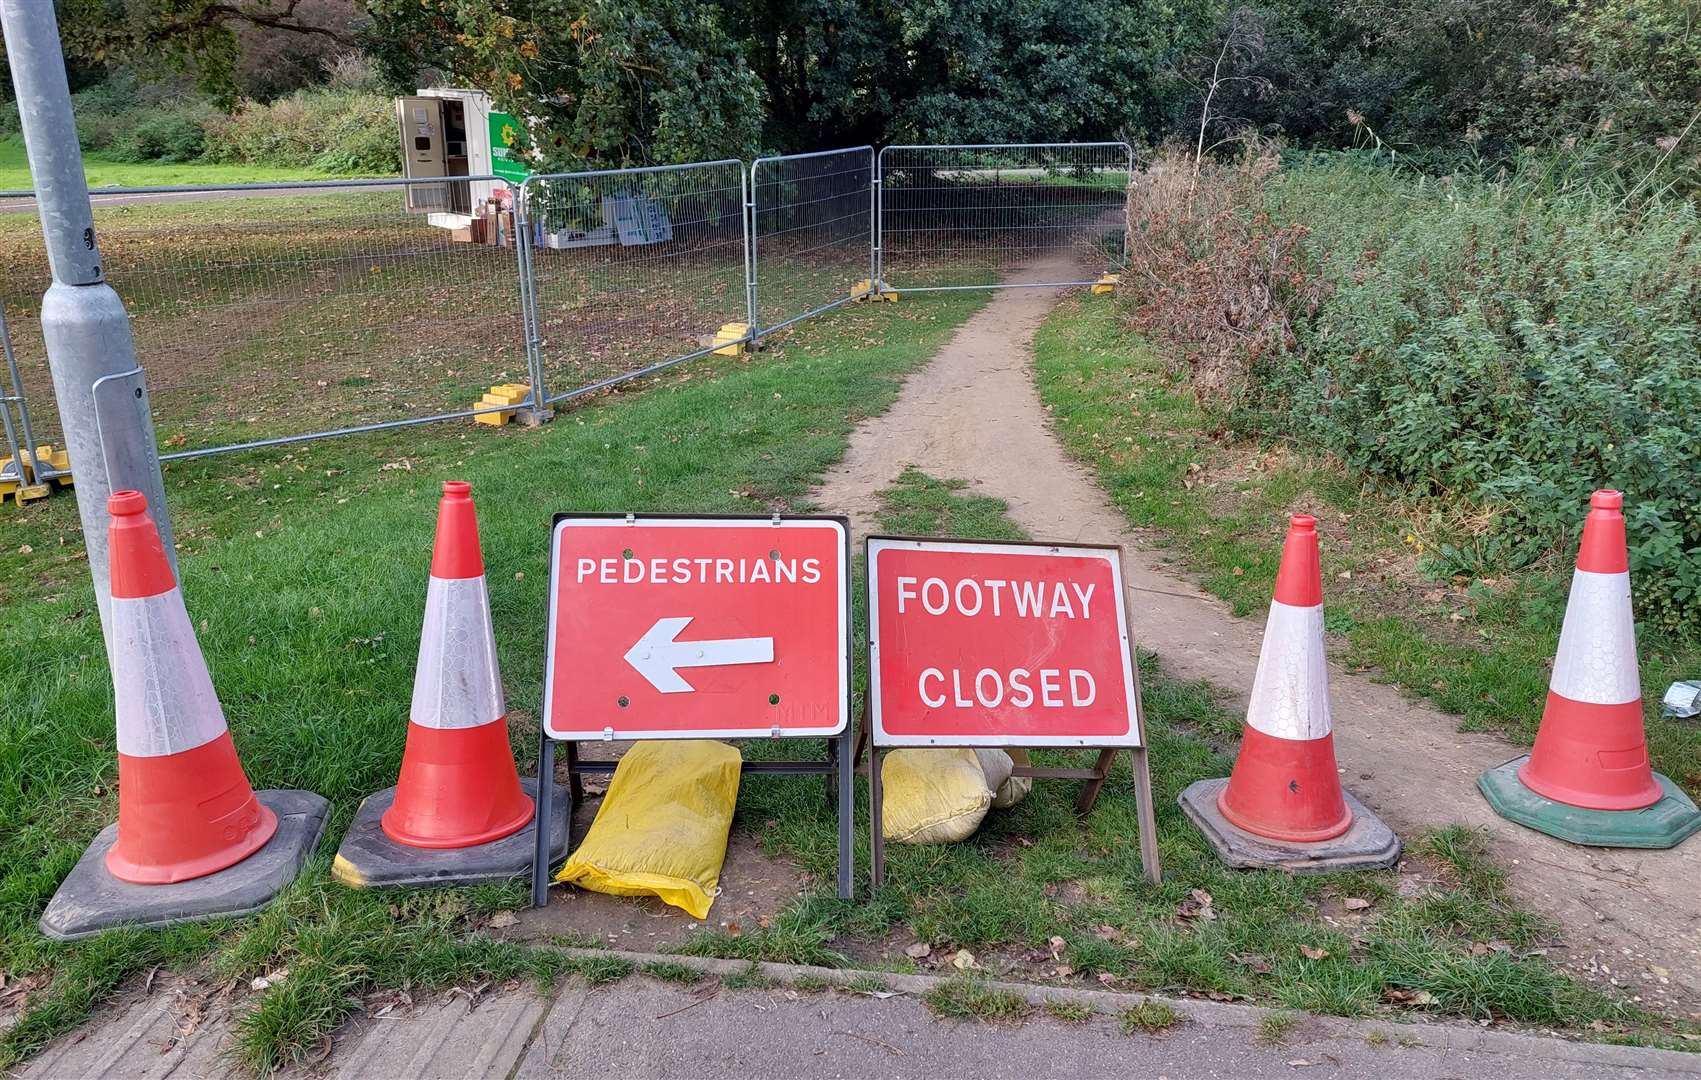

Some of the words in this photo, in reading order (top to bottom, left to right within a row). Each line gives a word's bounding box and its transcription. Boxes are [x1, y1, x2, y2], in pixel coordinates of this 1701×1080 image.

[576, 558, 821, 584] PEDESTRIANS
[897, 576, 1096, 619] FOOTWAY
[918, 667, 1097, 708] CLOSED
